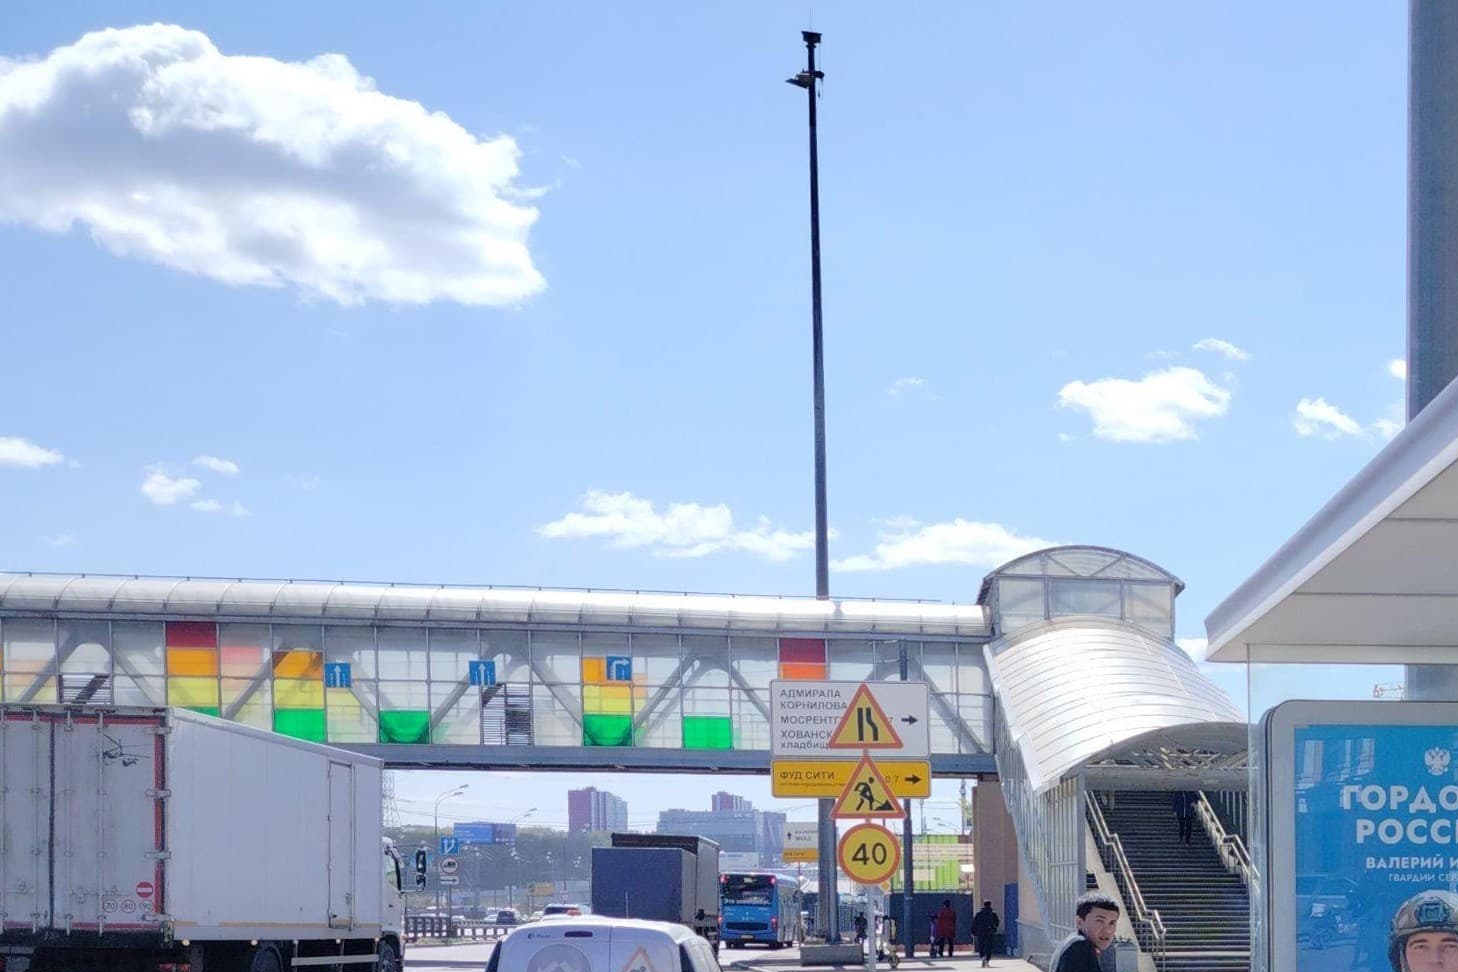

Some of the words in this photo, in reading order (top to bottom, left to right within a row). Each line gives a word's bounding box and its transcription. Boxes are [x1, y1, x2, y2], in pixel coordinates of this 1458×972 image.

[780, 689, 841, 698] АДМИРАЛА
[781, 701, 847, 710] КОРНИЛОВА
[780, 771, 802, 780] ФУД
[805, 771, 835, 780] СИТИ
[852, 842, 887, 865] 40
[1366, 854, 1443, 869] ВАЛЕРИЙ
[1388, 873, 1436, 882] ГВАРДИИ
